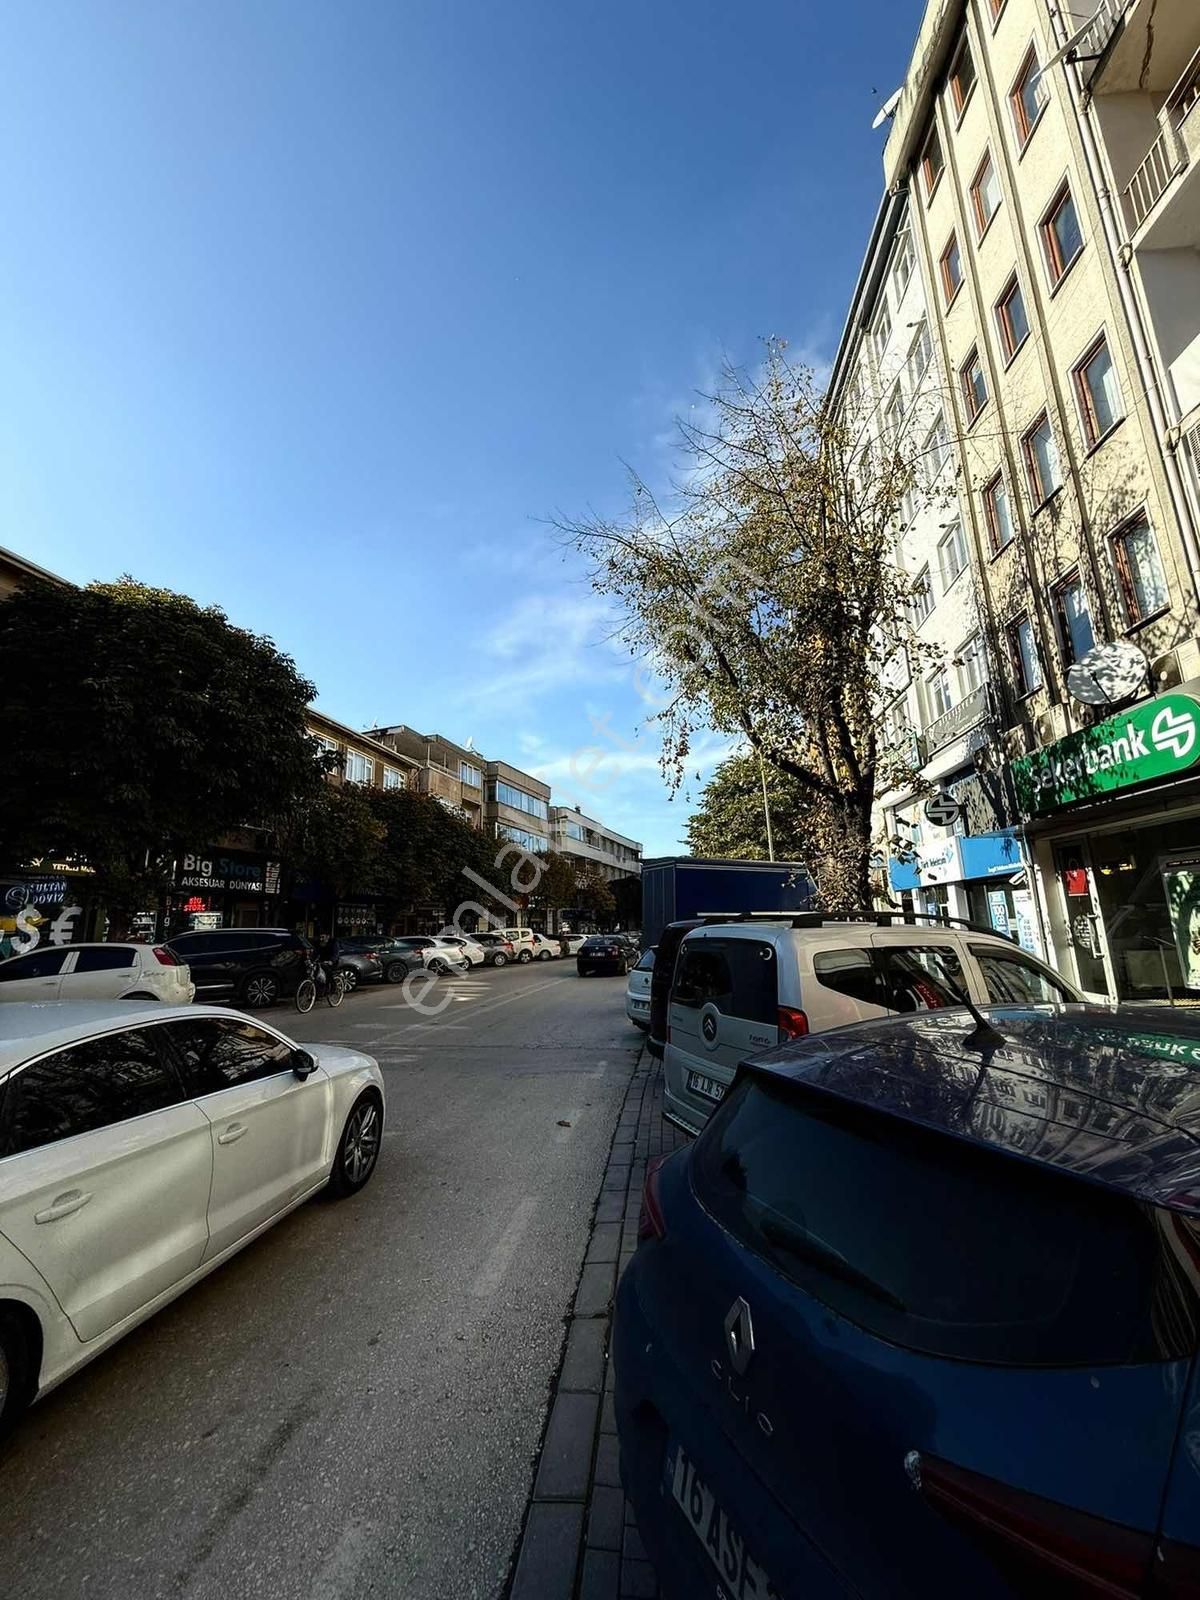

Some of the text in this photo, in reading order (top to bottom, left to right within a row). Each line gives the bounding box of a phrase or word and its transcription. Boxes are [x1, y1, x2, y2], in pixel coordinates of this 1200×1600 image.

[183, 853, 213, 876] Big
[218, 857, 262, 878] Store
[181, 876, 263, 892] AKSESUAR DÜNYASI
